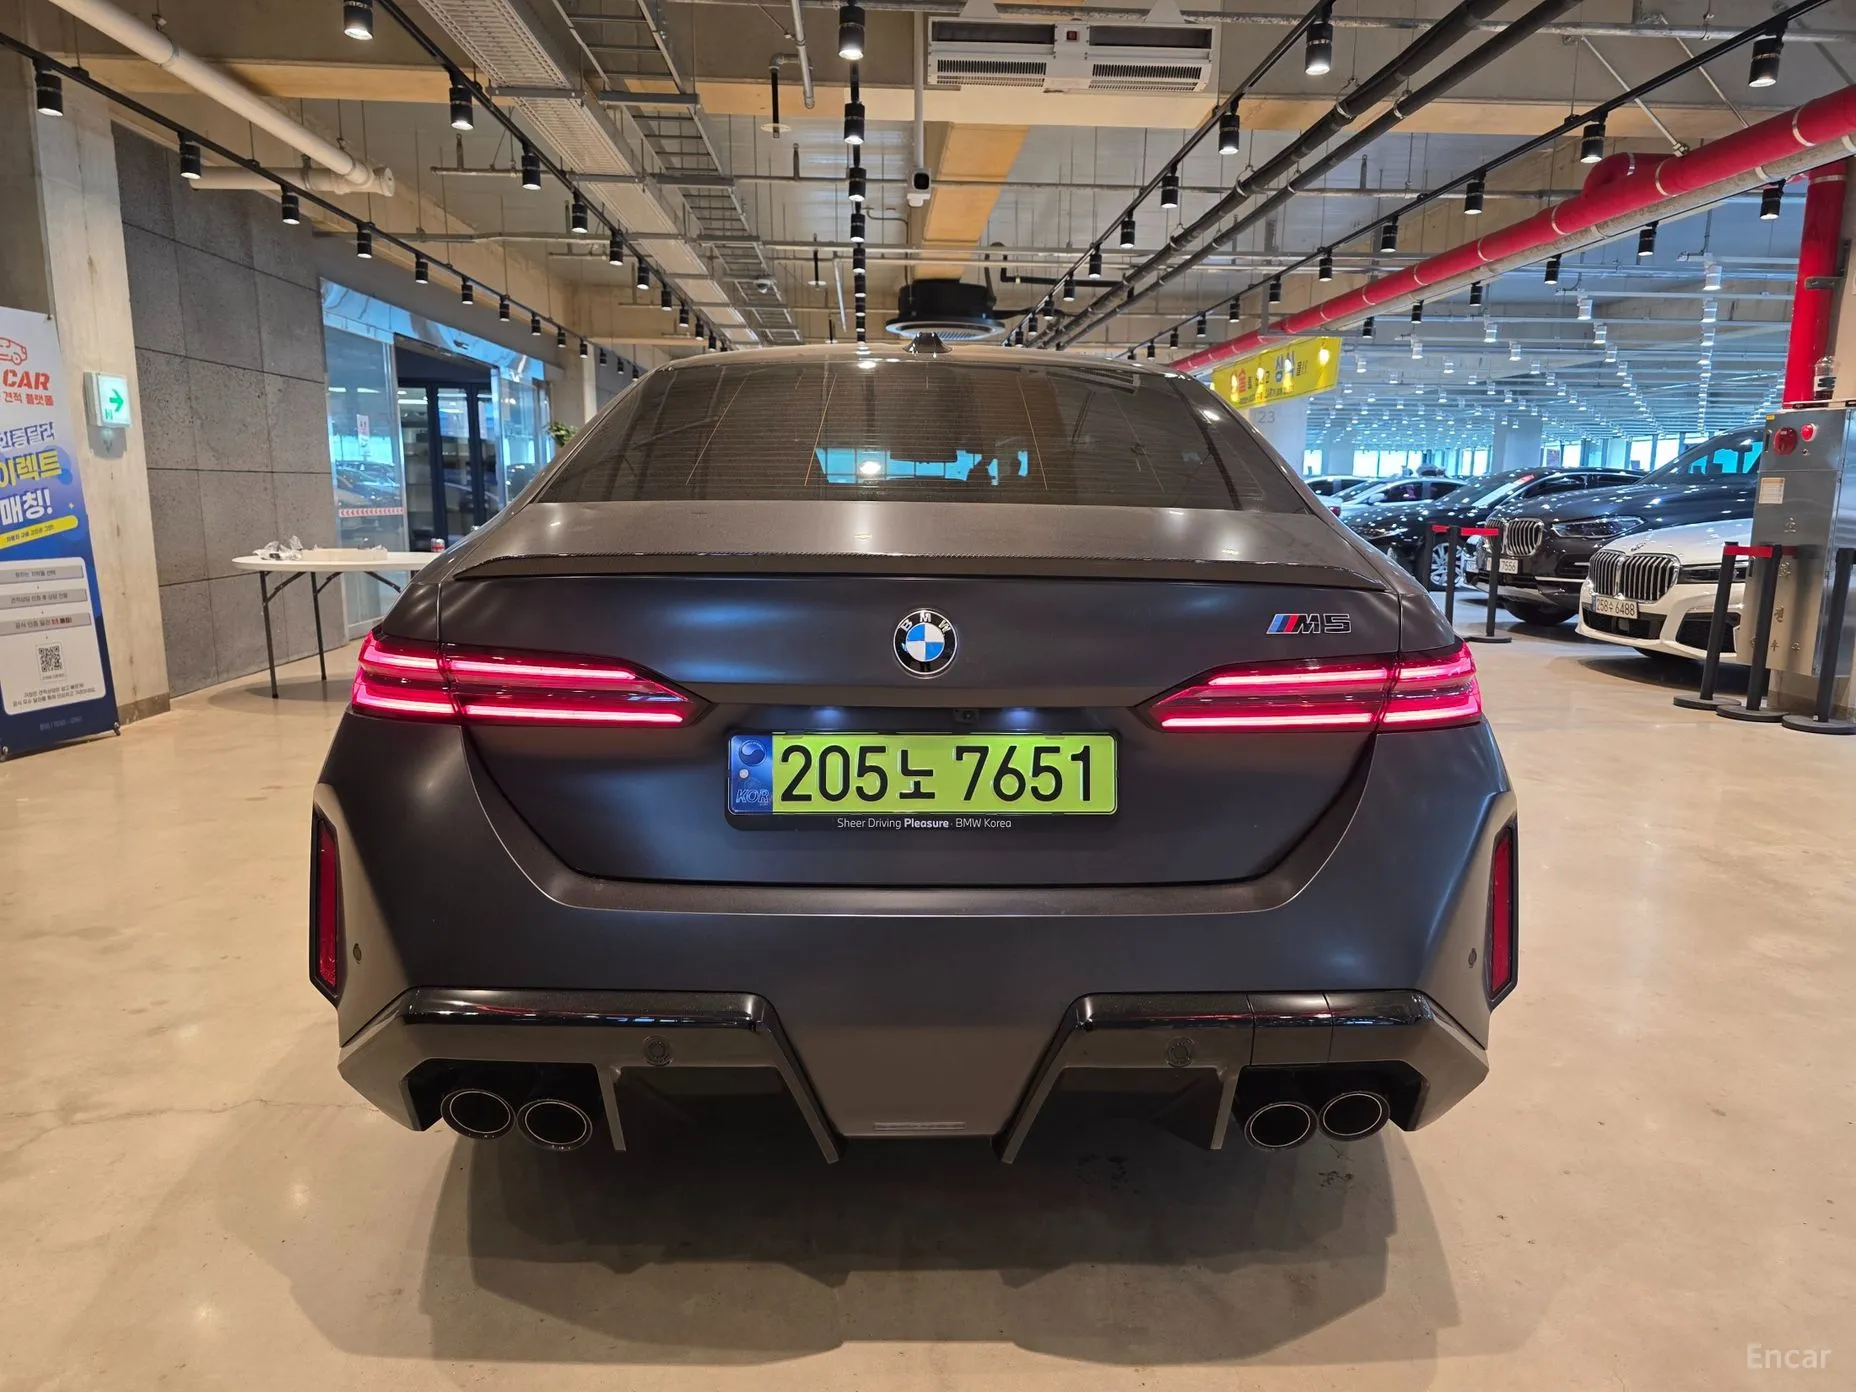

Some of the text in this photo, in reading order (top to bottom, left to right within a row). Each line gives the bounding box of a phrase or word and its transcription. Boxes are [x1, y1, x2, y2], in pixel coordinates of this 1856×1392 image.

[3, 369, 50, 391] CAR
[1257, 410, 1276, 424] 23
[900, 610, 951, 633] BMW
[1290, 613, 1351, 634] M5
[780, 745, 1092, 802] 205노 7651
[736, 789, 770, 803] KOR
[837, 818, 1012, 830] Sheer Driving Pleasure BMW Korea
